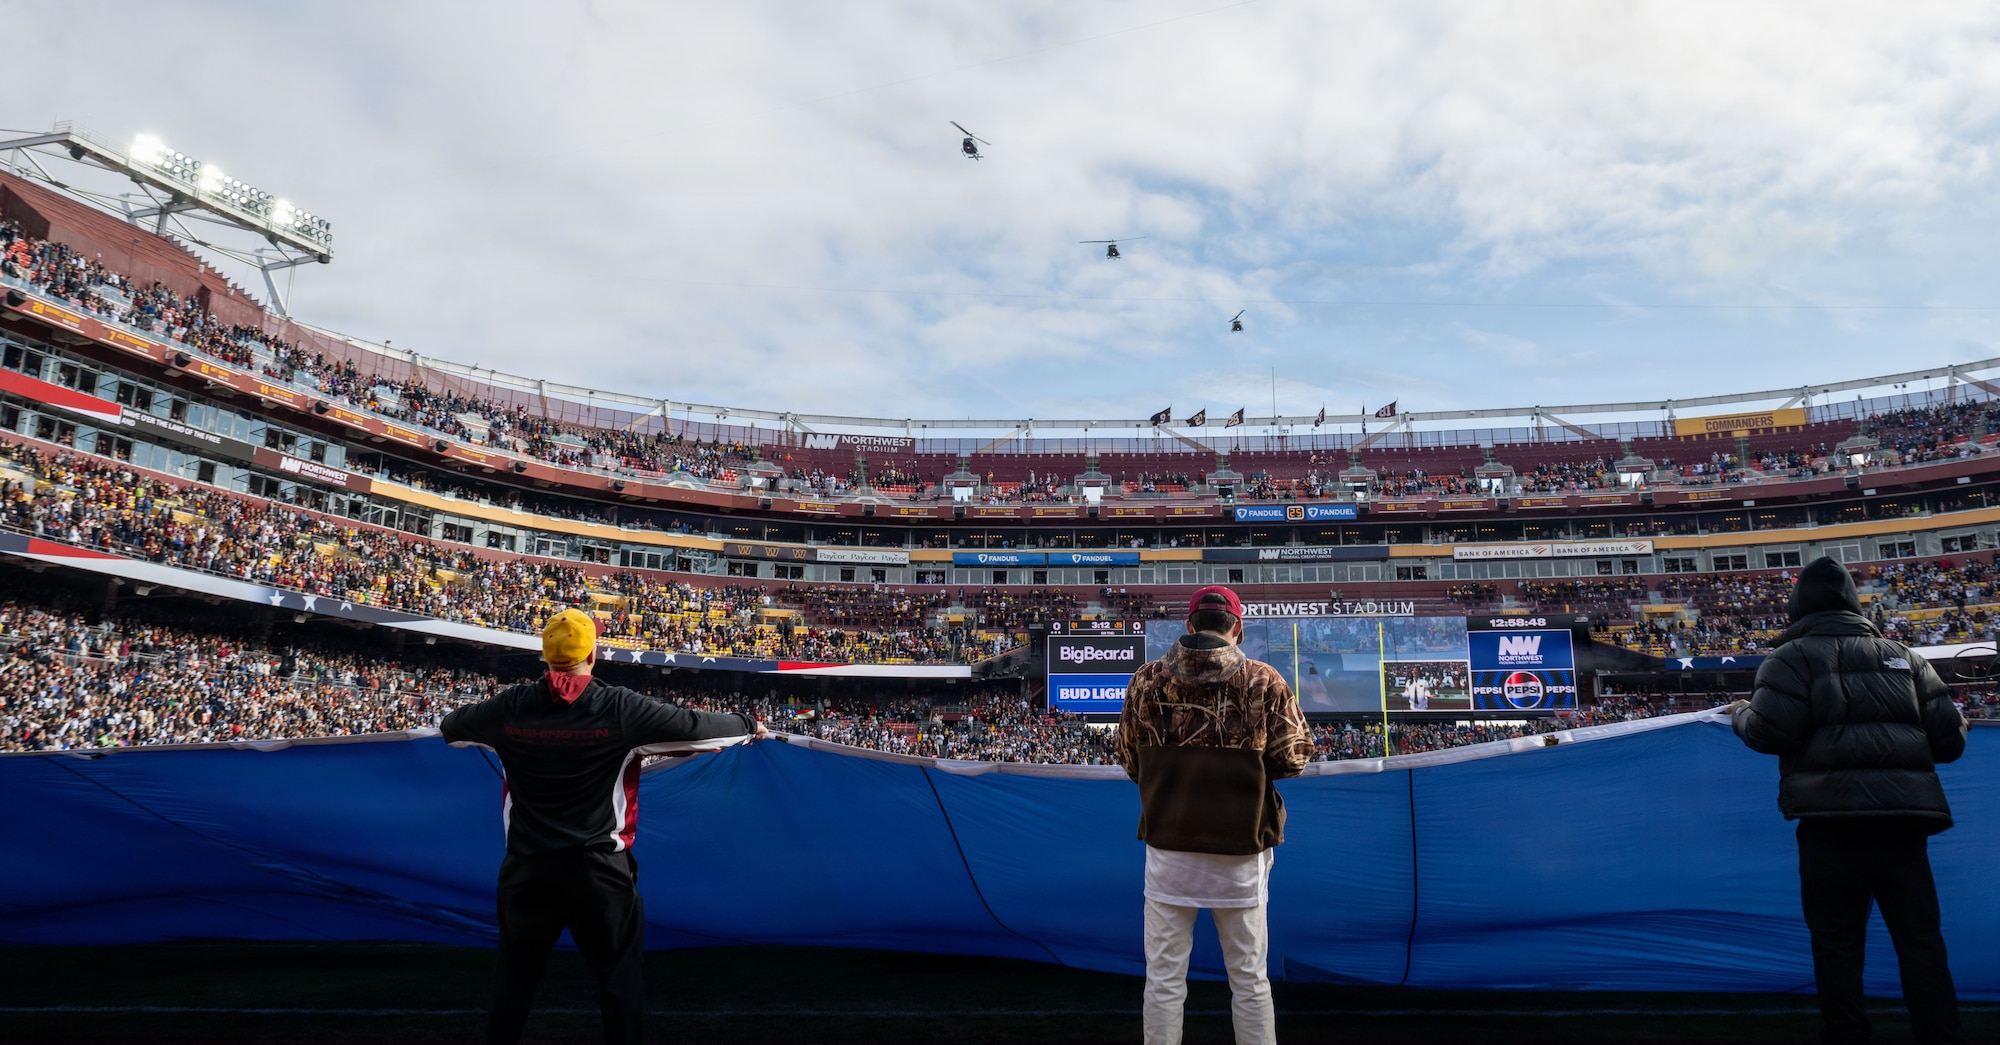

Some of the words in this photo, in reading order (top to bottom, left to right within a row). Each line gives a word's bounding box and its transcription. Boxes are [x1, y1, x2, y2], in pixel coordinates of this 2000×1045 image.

[121, 417, 136, 427] AND
[123, 409, 141, 420] WAVE
[156, 419, 169, 429] THE
[168, 423, 185, 433] LAND
[185, 428, 195, 436] OF
[194, 431, 206, 440] THE
[205, 434, 222, 445] FREE
[1705, 416, 1774, 432] COMMANDERS
[804, 433, 841, 450] NW
[842, 435, 913, 447] NORTHWEST
[856, 444, 899, 454] STADIUM
[280, 456, 303, 474] NW
[301, 462, 349, 481] NORTHWEST
[900, 507, 909, 515] 65
[980, 508, 987, 516] 17
[1289, 508, 1302, 518] 25
[1319, 508, 1355, 516] FANDUEL
[819, 552, 846, 561] Paycor
[850, 553, 877, 561] Paycor
[881, 554, 907, 562] Paycor
[1258, 549, 1280, 559] NW
[1240, 602, 1328, 615] ORTHWEST
[1332, 601, 1415, 615] STADIUM
[1052, 622, 1061, 631] 0
[1132, 622, 1141, 631] 0
[1489, 618, 1547, 627] 12:58:48
[1498, 636, 1542, 655] NW
[1060, 646, 1134, 664] BigBear.ai
[1059, 688, 1091, 700] BUD
[1092, 688, 1127, 700] LIGH
[1507, 686, 1541, 694] PEPSI
[1546, 686, 1575, 694] PEPSI
[503, 723, 609, 740] WASHINGTON
